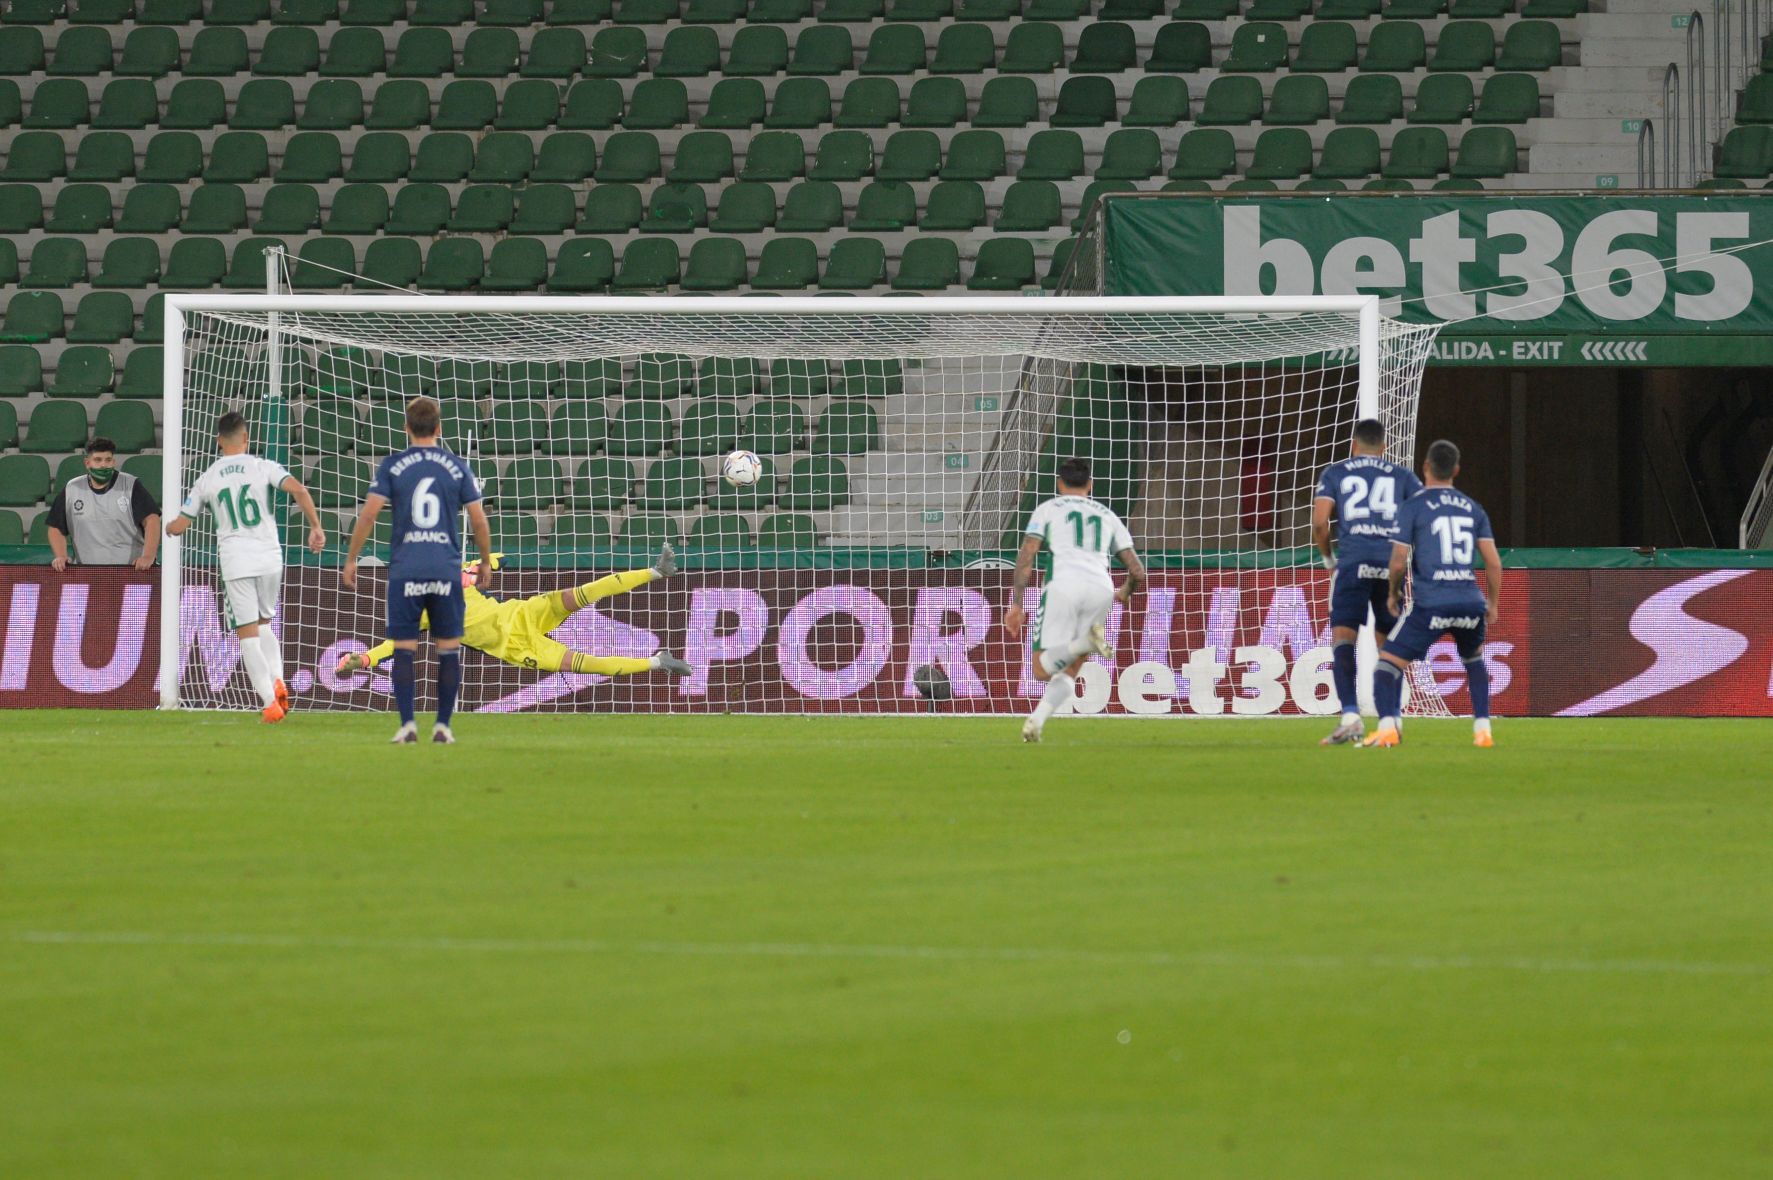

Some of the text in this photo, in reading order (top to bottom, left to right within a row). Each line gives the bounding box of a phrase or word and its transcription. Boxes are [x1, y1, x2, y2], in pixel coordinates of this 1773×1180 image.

[1601, 178, 1613, 186] 09
[1223, 204, 1754, 322] bet365
[1512, 341, 1563, 360] EXIT
[980, 400, 992, 409] 05
[219, 464, 246, 478] FIDEL
[389, 452, 423, 477] DENIS
[1345, 458, 1394, 473] MURILLO
[217, 483, 261, 530] 16
[411, 477, 440, 529] 6
[1340, 475, 1398, 521] 24
[1066, 510, 1102, 553] 11
[1431, 515, 1474, 565] 15
[1050, 646, 1411, 715] bet36
